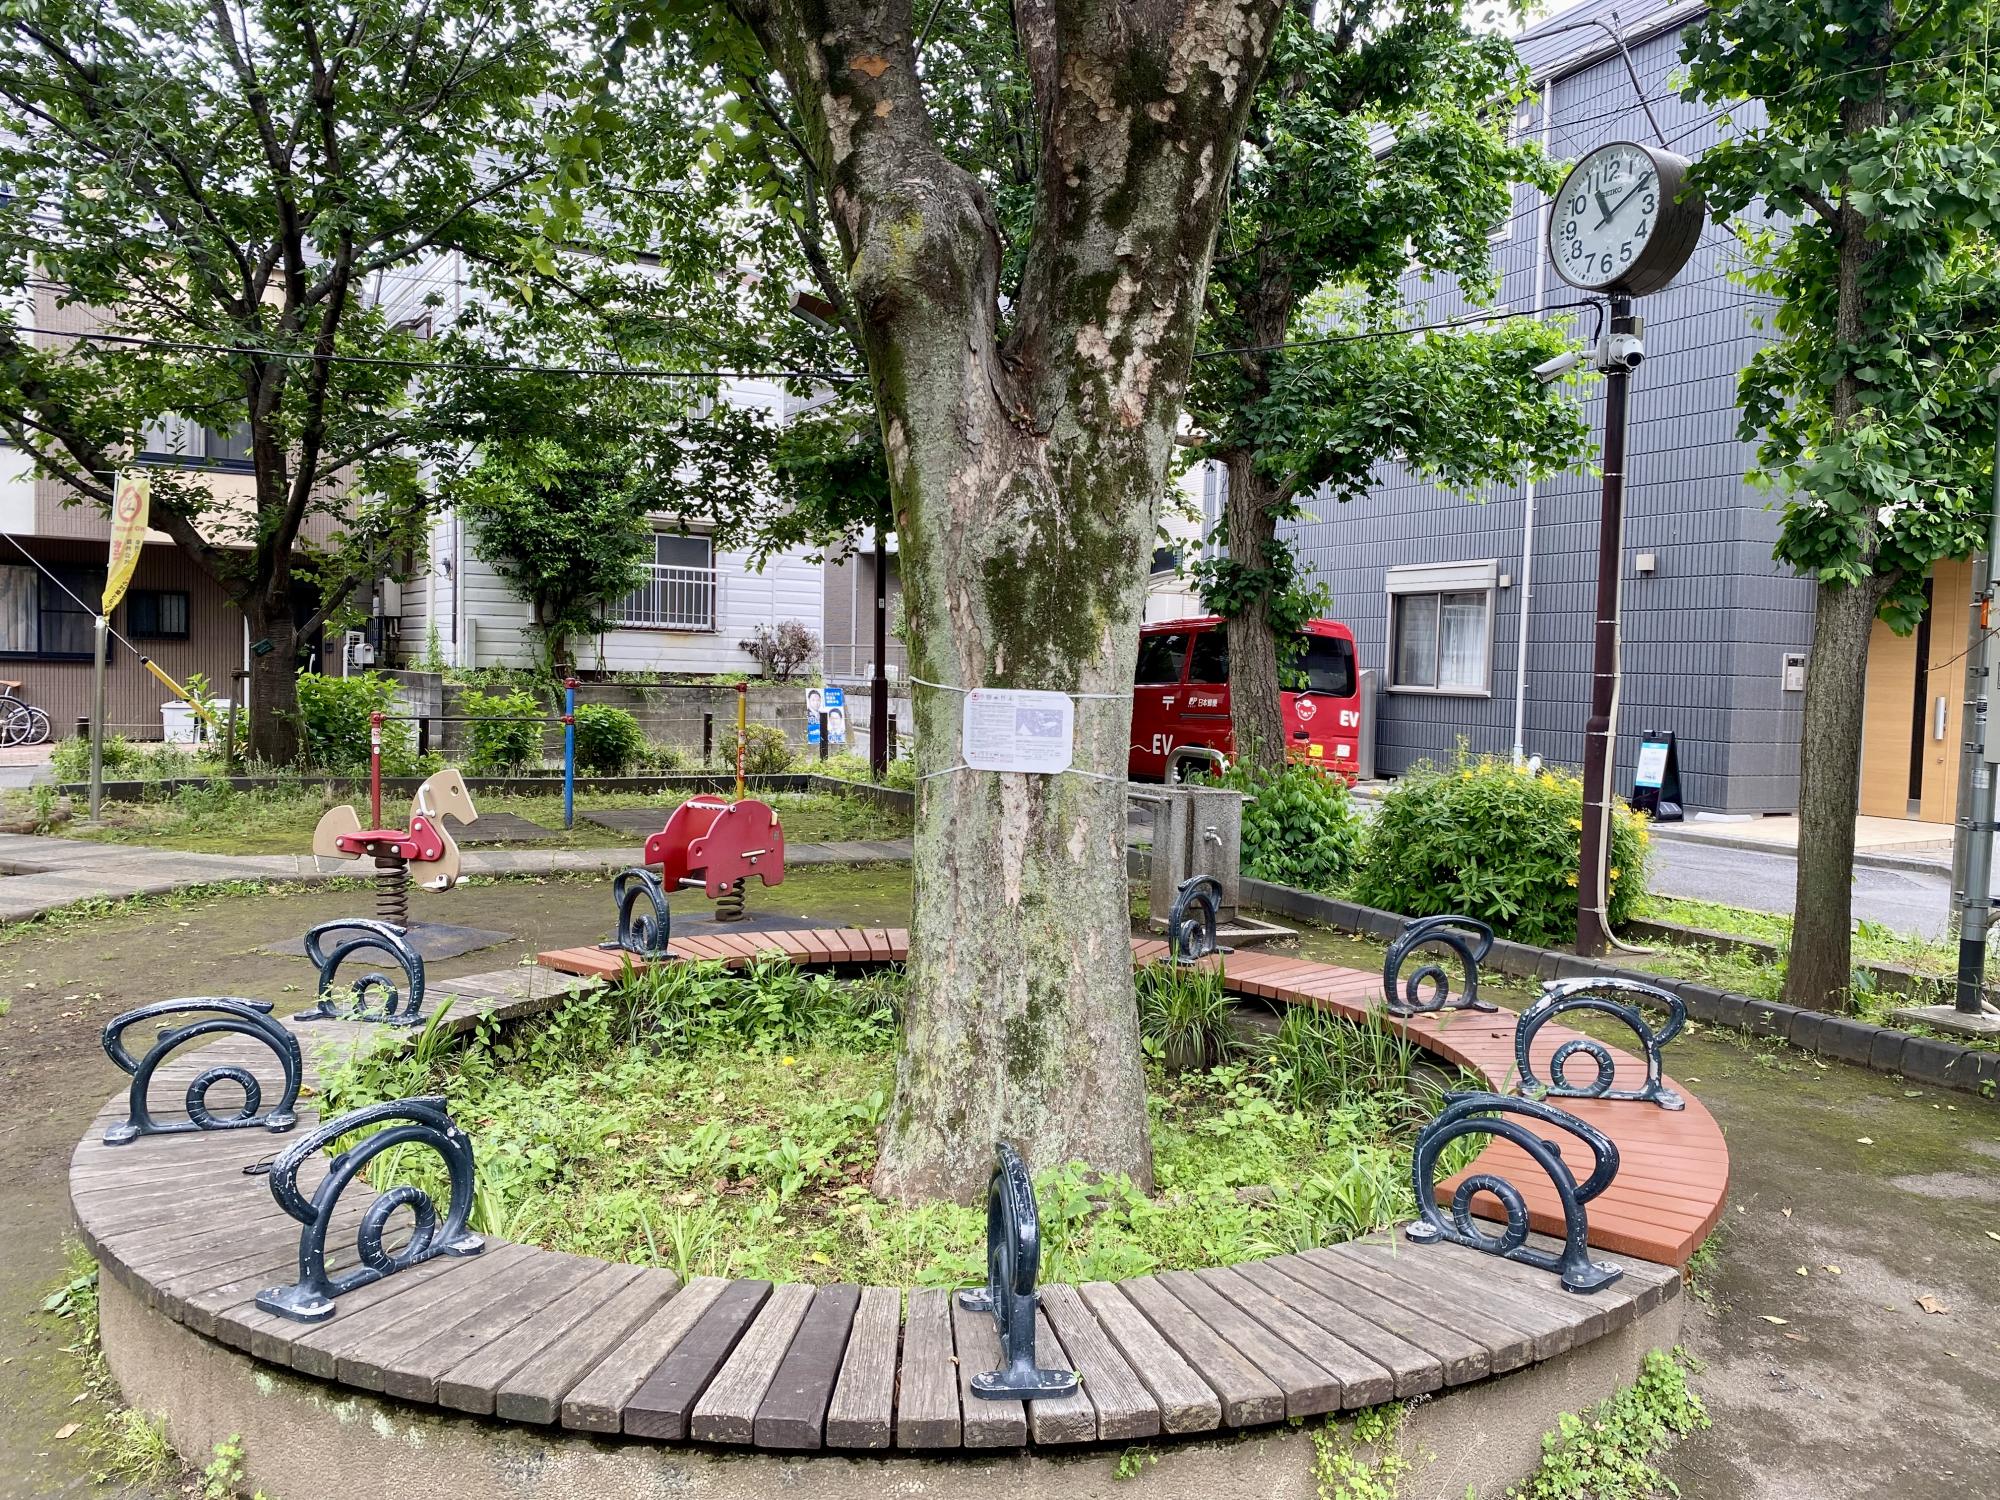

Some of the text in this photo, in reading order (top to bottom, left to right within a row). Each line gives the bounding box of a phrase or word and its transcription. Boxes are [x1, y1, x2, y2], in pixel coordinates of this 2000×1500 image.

[1604, 160, 1620, 183] 12
[1638, 171, 1650, 192] 2
[1587, 172, 1599, 194] 11
[1571, 195, 1587, 217] 10
[1642, 194, 1655, 215] 3
[1566, 221, 1577, 241] 9
[1634, 219, 1647, 239] 4
[1571, 239, 1582, 260] 8
[1619, 241, 1632, 262] 5
[1585, 253, 1596, 273] 7
[1600, 254, 1612, 274] 6
[1339, 710, 1360, 728] EV
[1152, 734, 1174, 756] EV
